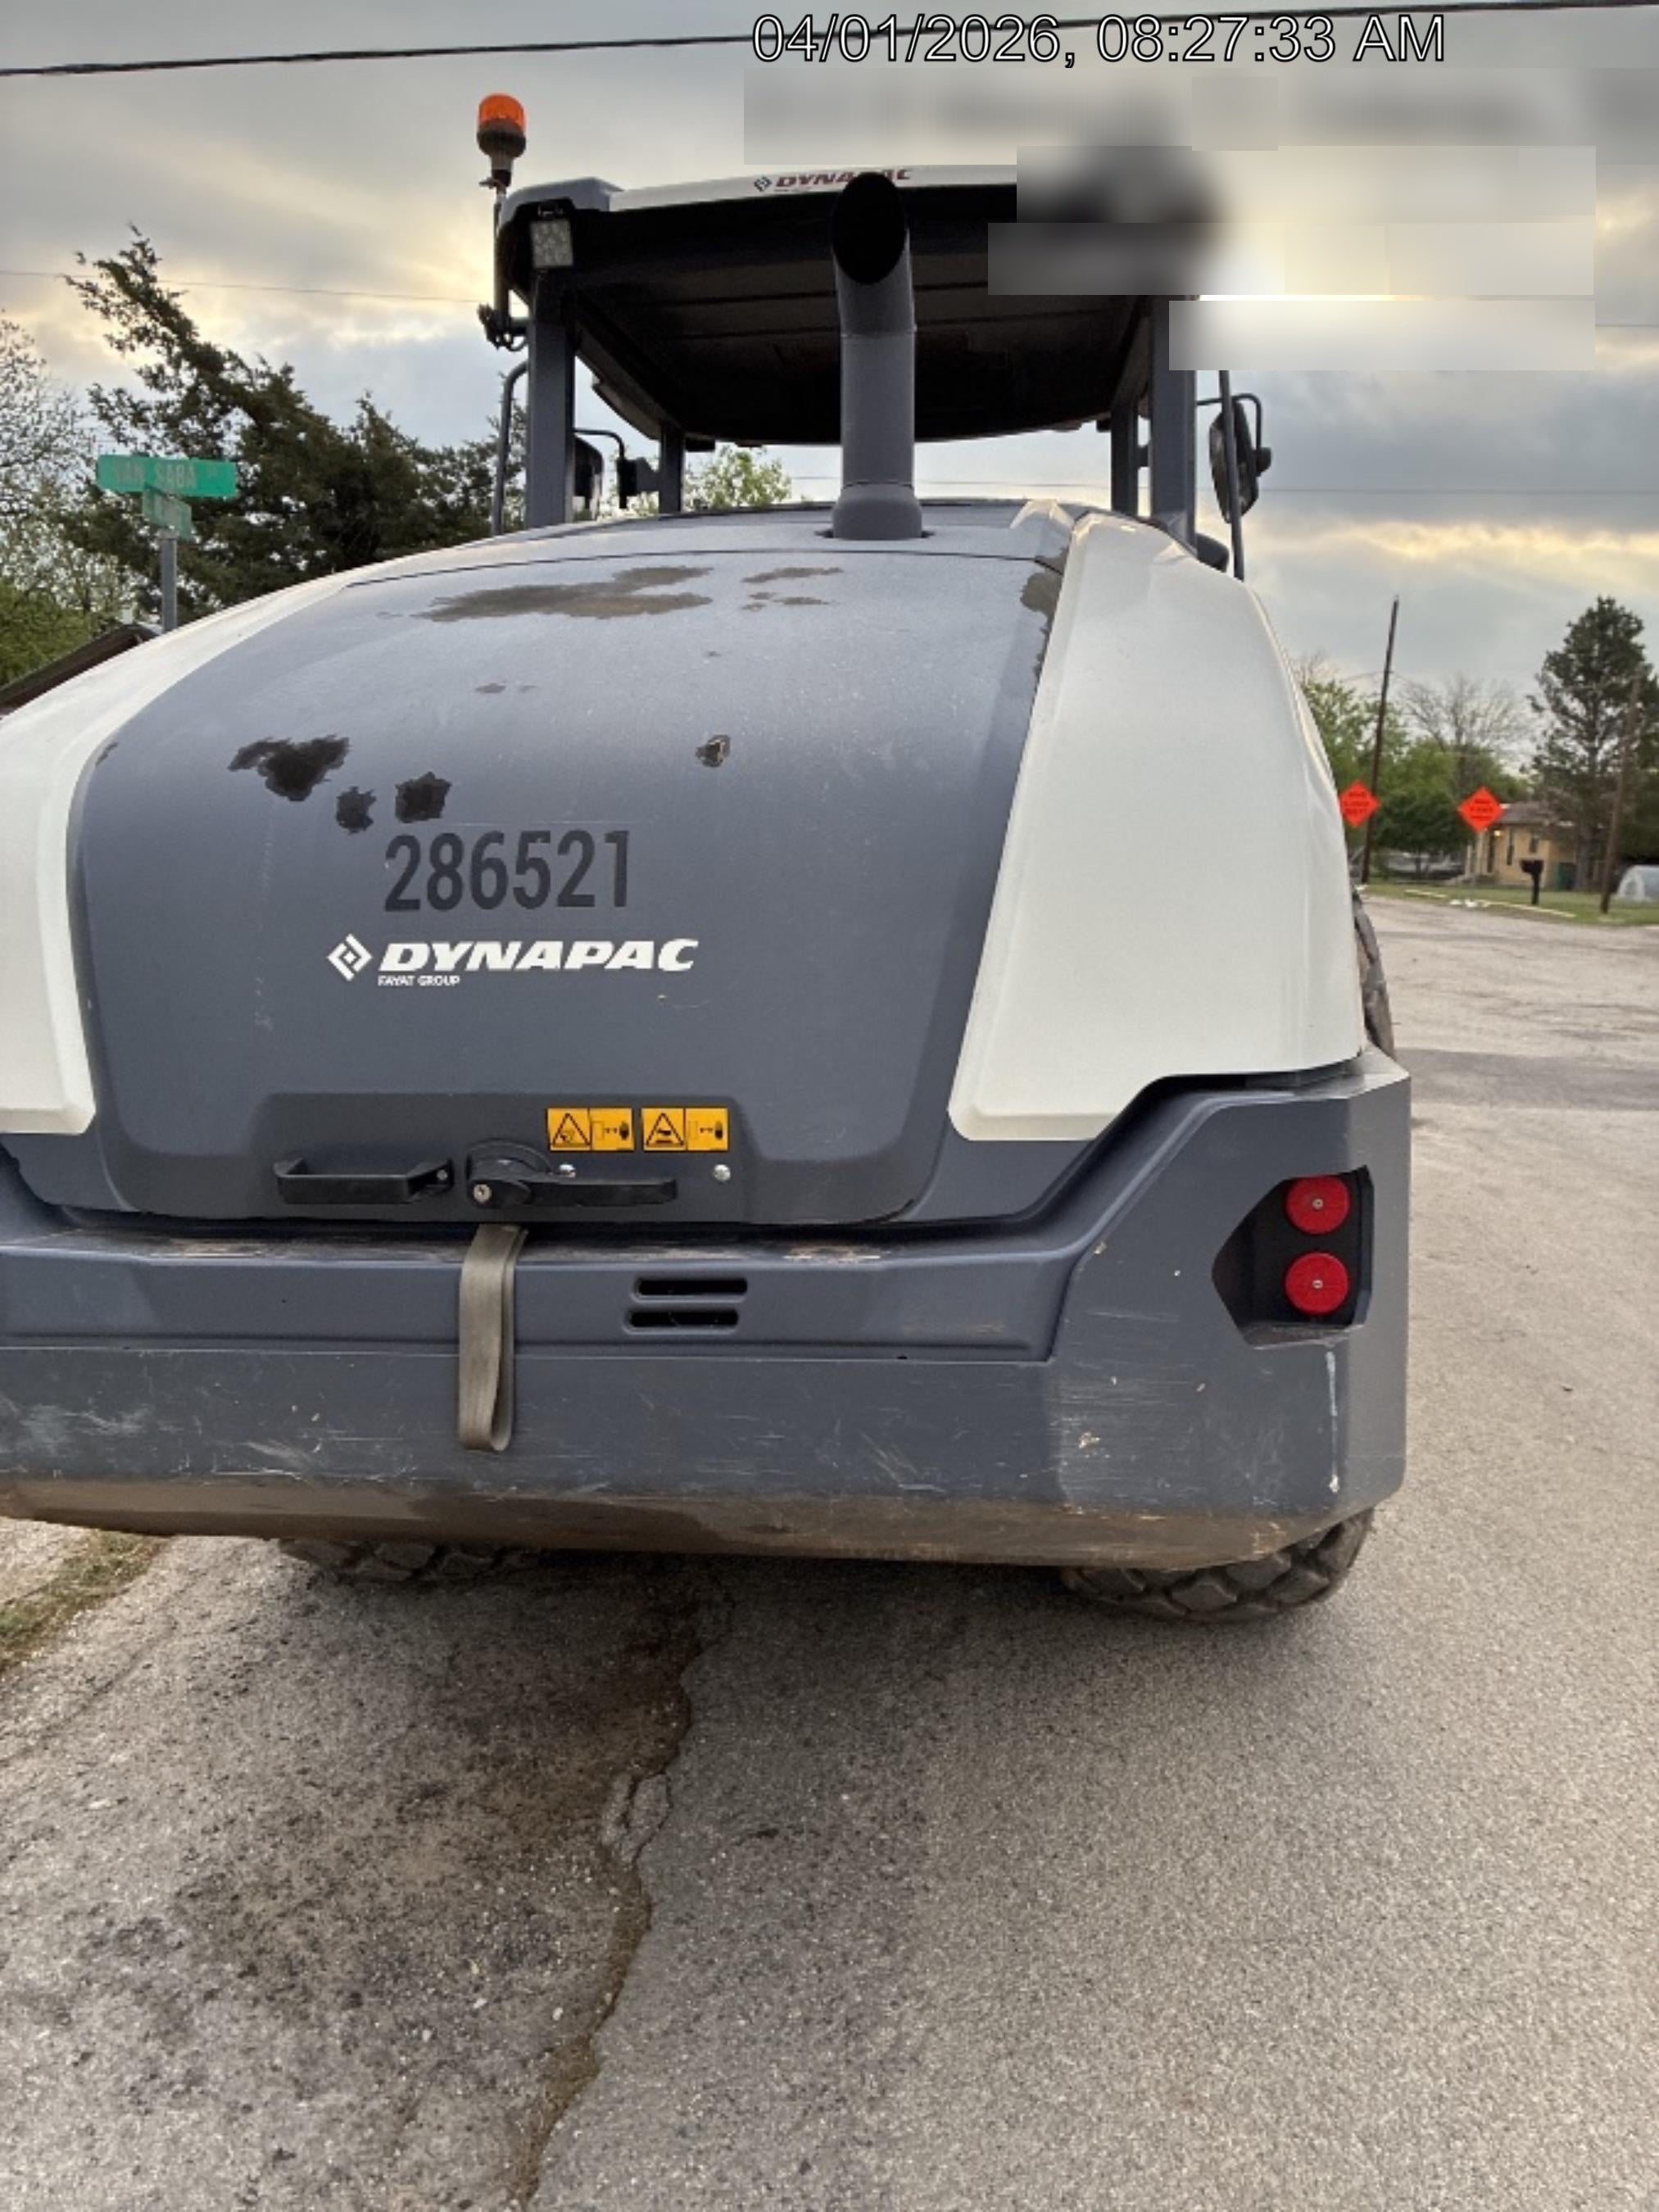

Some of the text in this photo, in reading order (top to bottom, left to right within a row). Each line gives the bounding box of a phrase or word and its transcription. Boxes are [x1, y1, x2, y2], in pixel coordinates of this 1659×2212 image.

[384, 829, 629, 912] 286521
[378, 938, 699, 972] DYNAPAC
[378, 975, 460, 986] FAYAT GROUP
